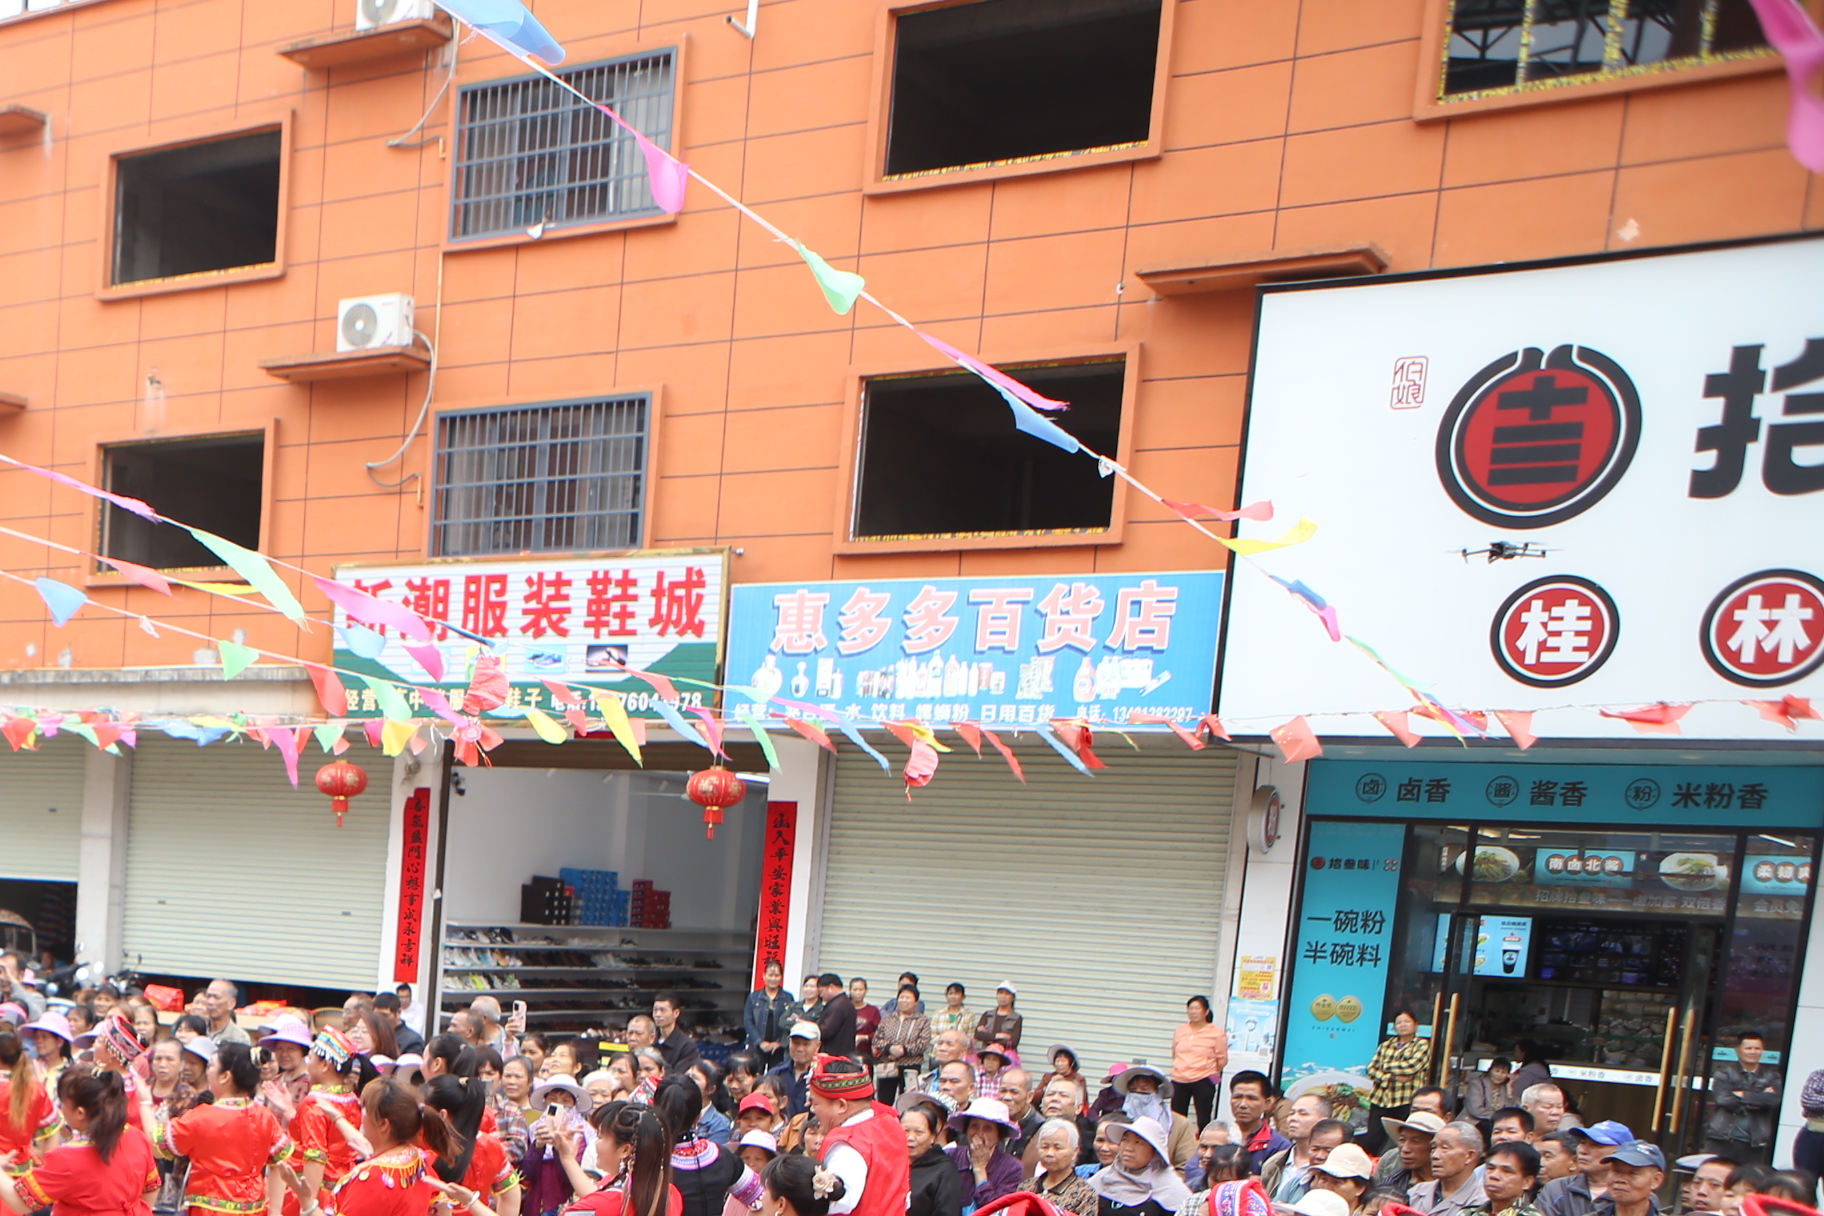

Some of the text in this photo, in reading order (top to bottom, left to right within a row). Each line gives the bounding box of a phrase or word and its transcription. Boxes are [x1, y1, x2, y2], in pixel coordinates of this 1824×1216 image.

[769, 578, 1178, 656] 惠多多百货店
[1515, 594, 1814, 665] 桂 林
[871, 702, 906, 721] 饮料
[980, 703, 1055, 723] 日用百货
[1397, 777, 1451, 803] 卤香
[1529, 779, 1588, 807] 酱香
[1671, 782, 1769, 810] 米粉香
[1307, 909, 1386, 935] 一碗粉
[1303, 940, 1382, 968] 半碗料
